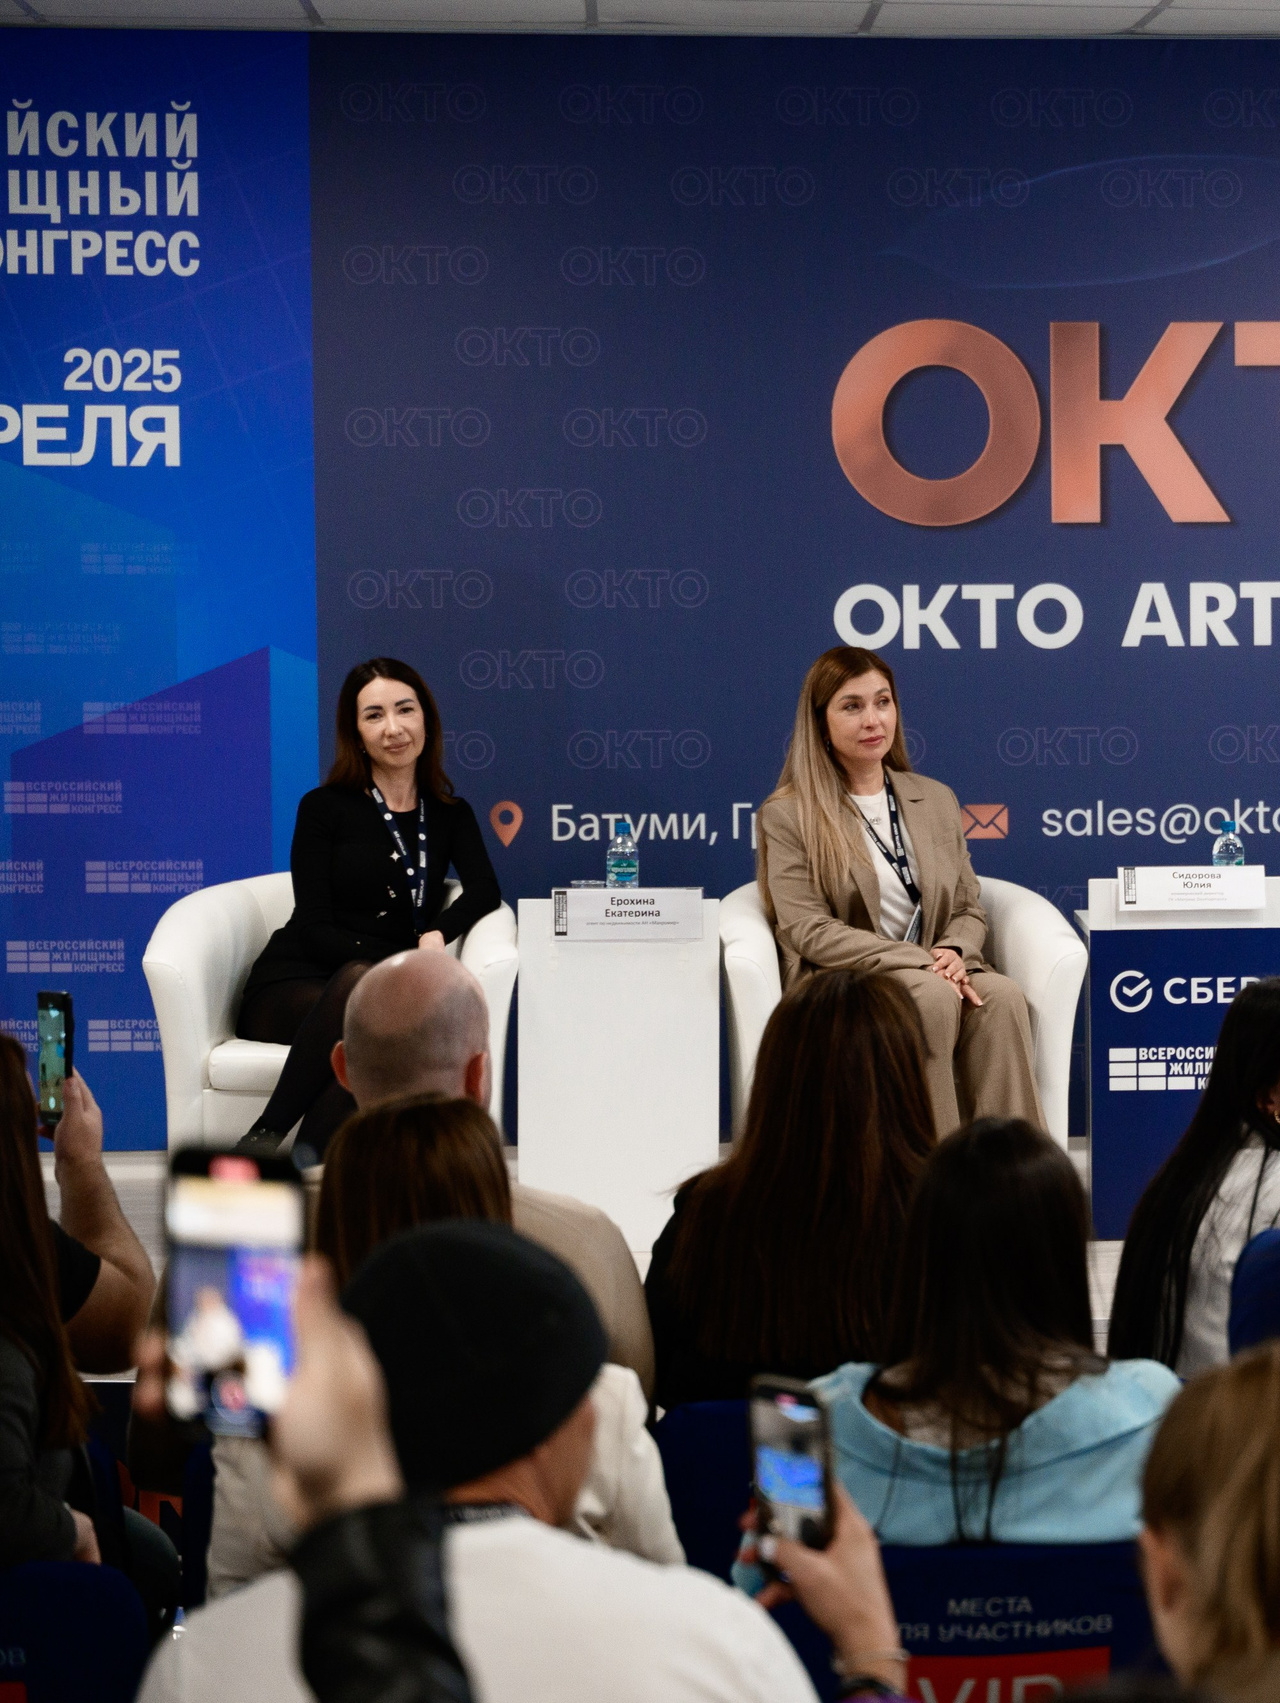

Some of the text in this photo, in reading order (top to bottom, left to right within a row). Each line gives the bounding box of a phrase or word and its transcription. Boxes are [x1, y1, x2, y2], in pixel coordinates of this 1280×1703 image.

[6, 99, 198, 158] ЙСКИЙ
[8, 158, 199, 223] ЩНЫЙ
[0, 229, 200, 277] НГРЕСС
[64, 348, 181, 393] 2025
[834, 582, 1083, 650] OKTO
[26, 780, 122, 791] ВСЕРОССИЙСКИЙ
[49, 791, 122, 803] ЖИЛИЩНЫЙ
[71, 803, 122, 814] КОНГРЕСС
[552, 804, 718, 846] Батуми,
[107, 859, 203, 870] ВСЕРОССИЙСКИЙ
[131, 870, 203, 882] ЖИЛИЩНЫЙ
[1172, 871, 1222, 880] Сидорова
[1182, 881, 1212, 889] Юлия
[610, 896, 655, 907] Ерохина
[605, 908, 661, 918] Екатерина
[29, 939, 125, 950] ВСЕРОССИЙСКИЙ
[51, 950, 125, 962] ЖИЛИЩНЫЙ
[74, 962, 125, 973] КОНГРЕСС
[1139, 1047, 1217, 1060] ВСЕРОССИ
[946, 1595, 1034, 1617] МЕСТА
[938, 1613, 1113, 1643] УЧАСТНИКОВ
